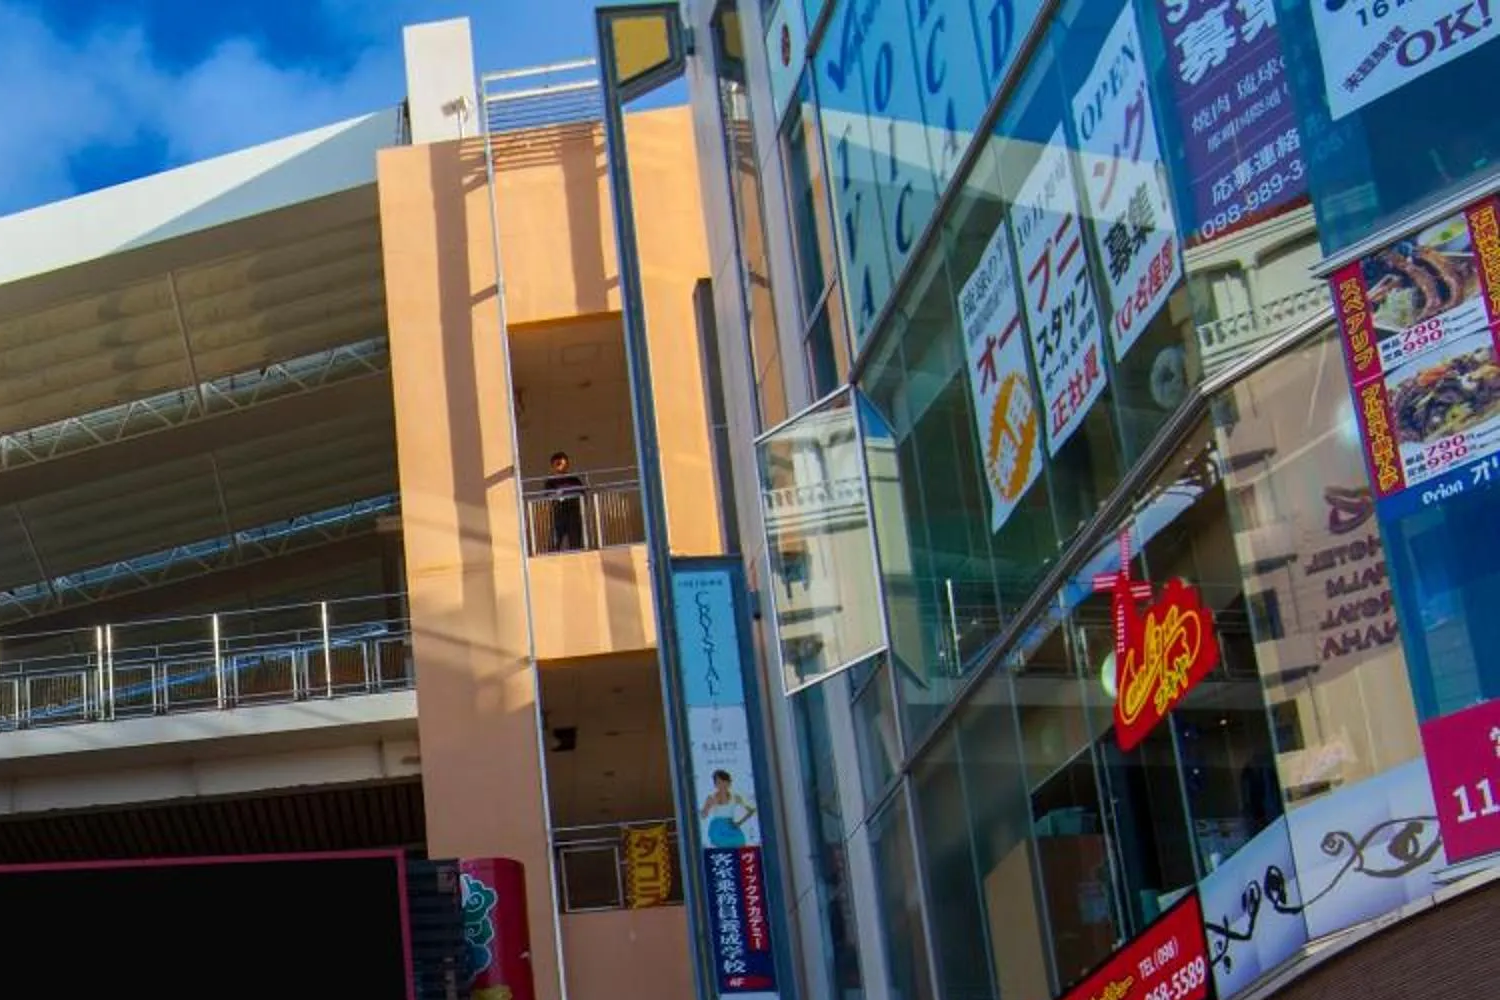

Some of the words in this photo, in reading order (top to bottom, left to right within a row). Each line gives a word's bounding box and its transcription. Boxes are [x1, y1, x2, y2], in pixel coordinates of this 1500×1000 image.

[1080, 30, 1137, 141] OPEN
[1051, 343, 1099, 438] 正社員
